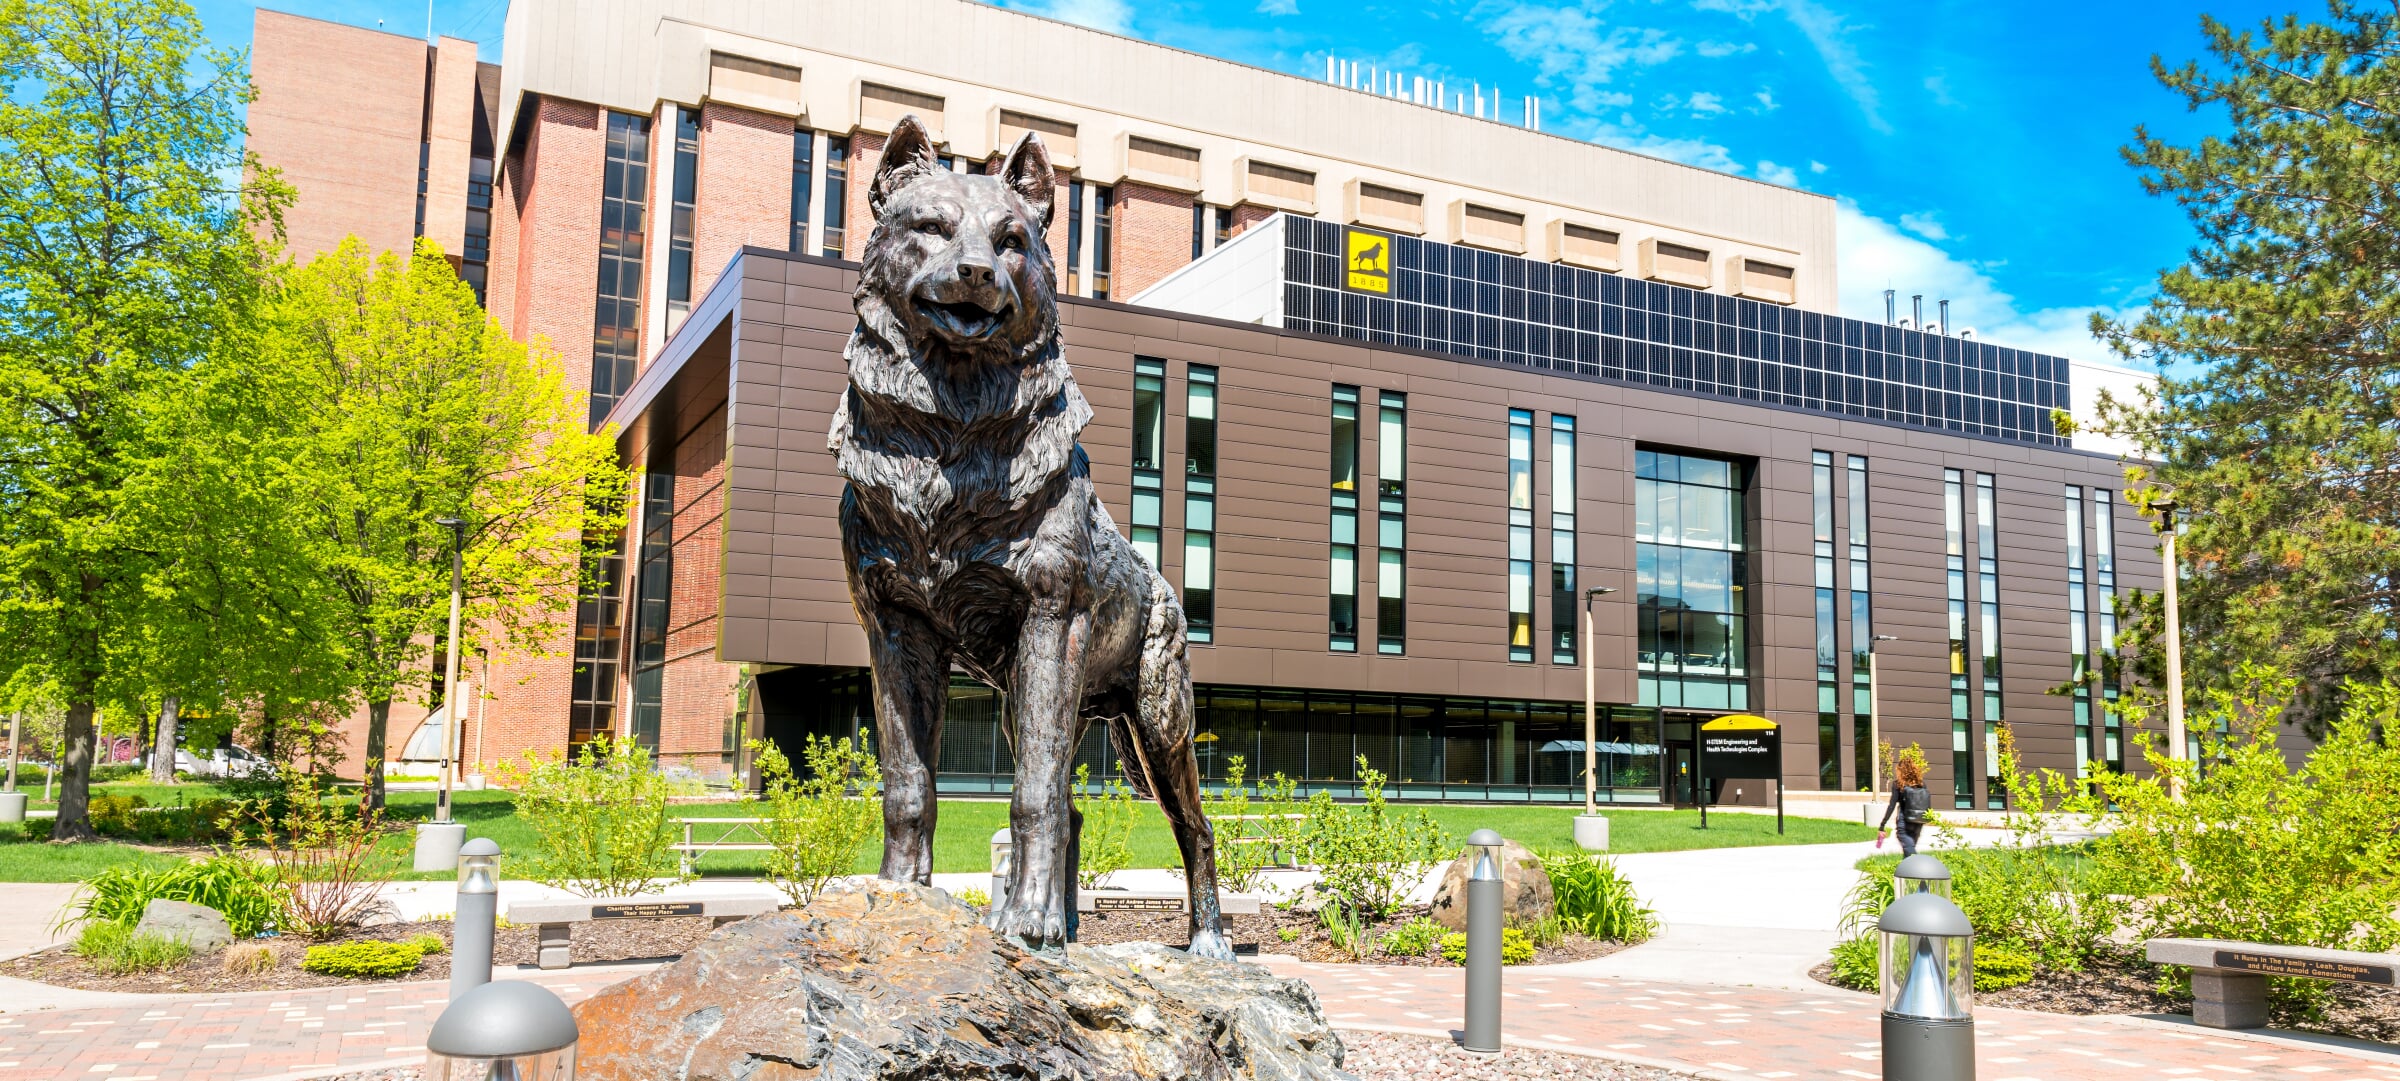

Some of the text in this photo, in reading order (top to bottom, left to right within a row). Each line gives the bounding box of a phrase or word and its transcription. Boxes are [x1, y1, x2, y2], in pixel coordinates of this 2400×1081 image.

[1353, 276, 1384, 289] 1885
[1724, 738, 1748, 746] Engineering
[1748, 746, 1768, 754] Complex
[2241, 954, 2258, 962] Runs
[2284, 959, 2306, 968] Family
[2315, 962, 2335, 971] Leah,
[2337, 964, 2370, 974] Douglas,
[2262, 964, 2284, 972] Future
[2286, 966, 2309, 975] Arnold
[2311, 969, 2356, 980] Generations
